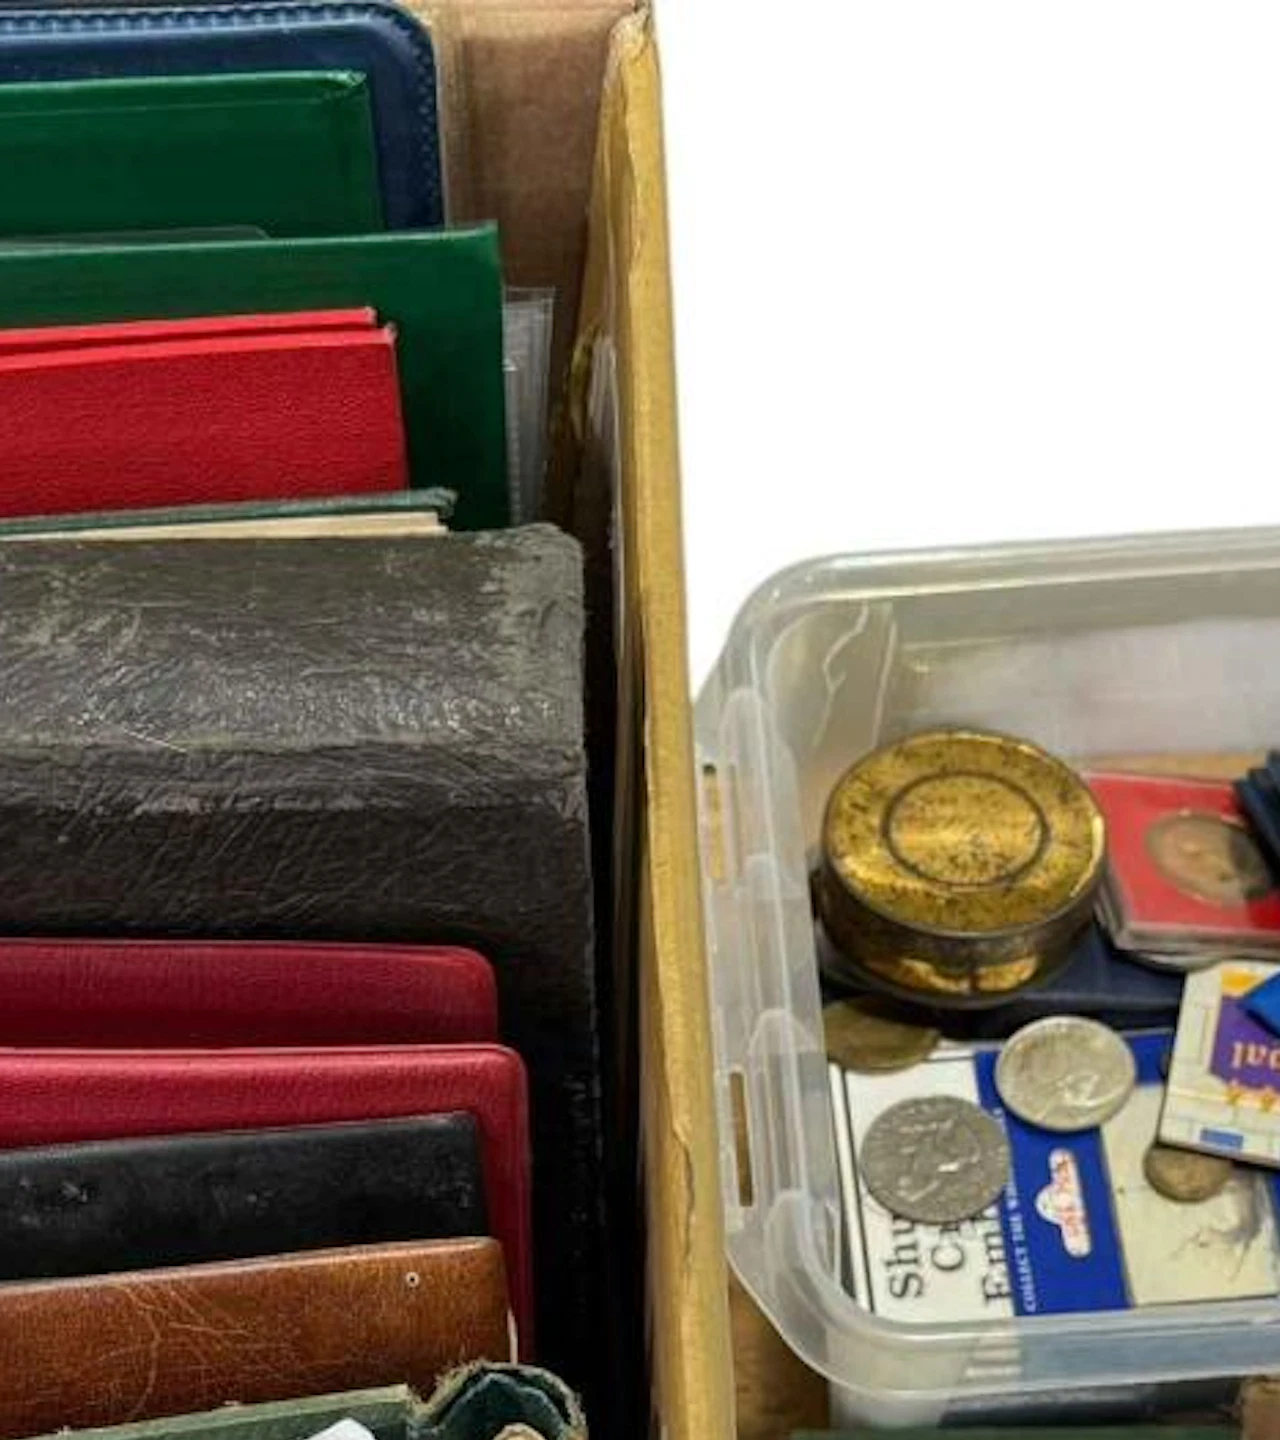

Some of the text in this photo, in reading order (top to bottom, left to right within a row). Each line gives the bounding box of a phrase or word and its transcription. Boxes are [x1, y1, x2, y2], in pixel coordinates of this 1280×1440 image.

[885, 1213, 924, 1299] Shu
[1008, 1213, 1026, 1242] THE
[1014, 1246, 1038, 1313] COLLECT
